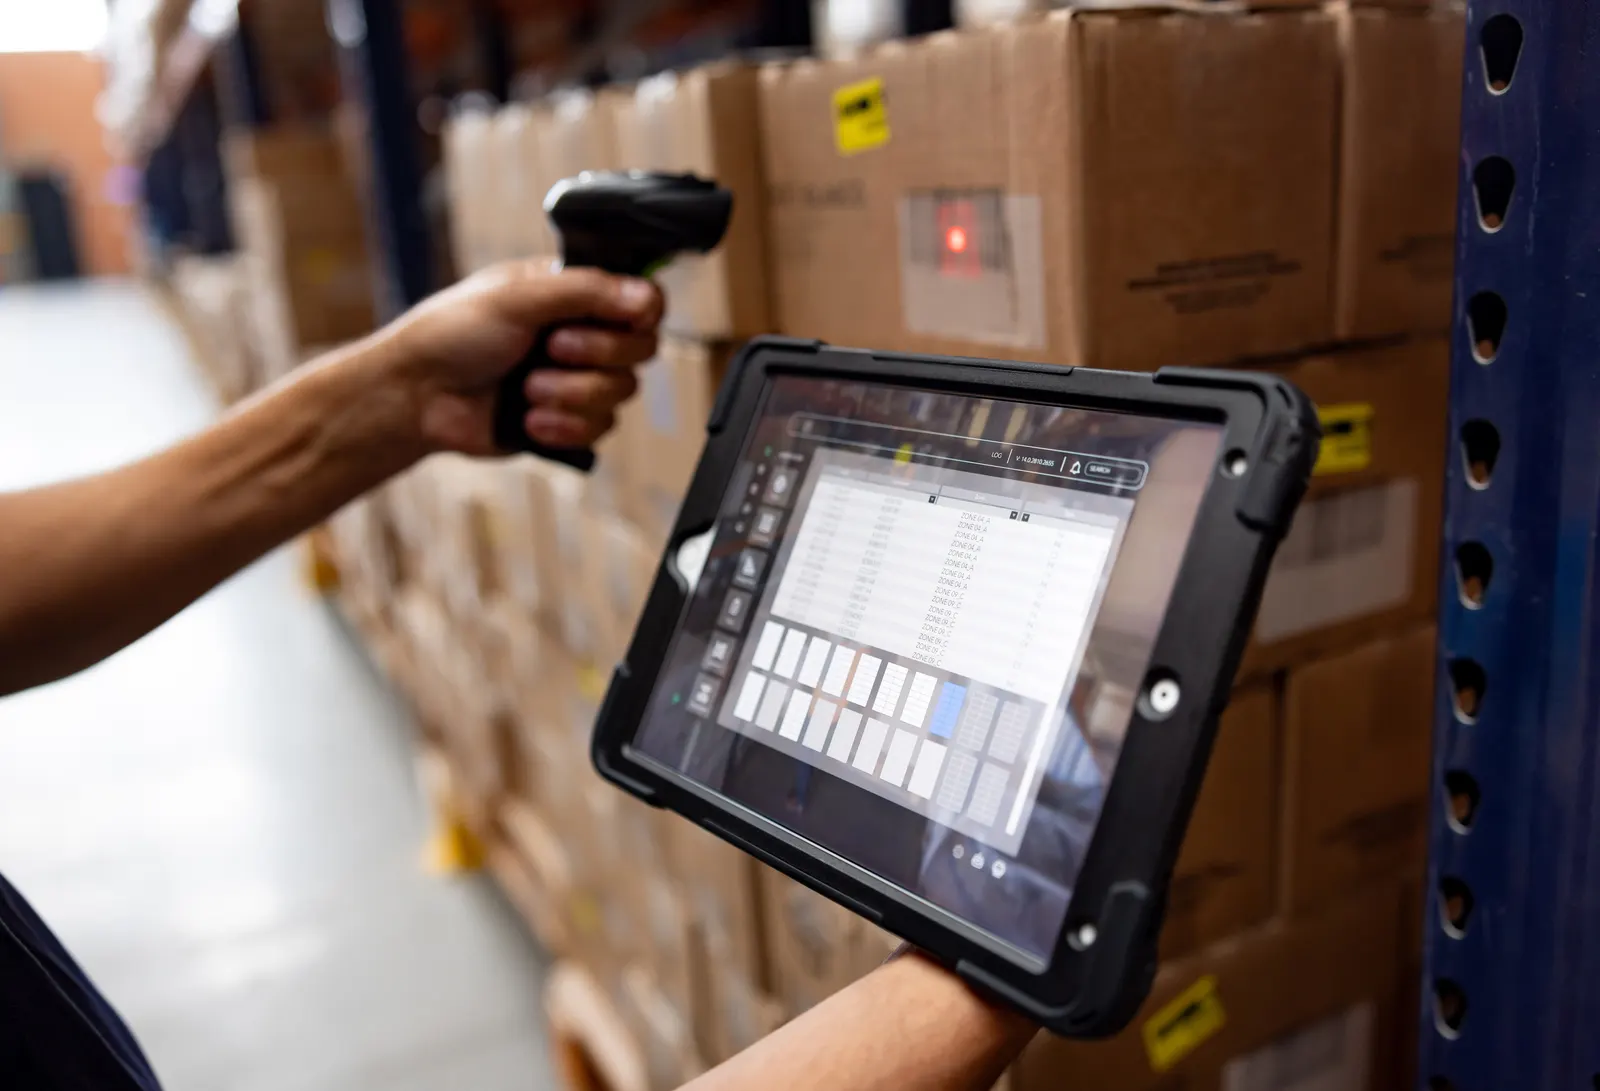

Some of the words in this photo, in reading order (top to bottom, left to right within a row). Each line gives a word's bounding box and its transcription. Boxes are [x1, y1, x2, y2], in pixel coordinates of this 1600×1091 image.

[991, 451, 1002, 459] LOG
[1089, 465, 1111, 474] SEARCH
[961, 512, 977, 521] ZONE
[958, 521, 974, 530] ZONE
[974, 524, 987, 532] 04_A
[955, 531, 970, 539] ZONE
[971, 534, 983, 542] 04_A
[951, 540, 967, 549] ZONE
[968, 543, 981, 552] 04_A
[948, 549, 964, 558] ZONE
[964, 553, 977, 561] 04_A
[945, 558, 960, 567] ZONE
[961, 562, 973, 571] 04_A
[941, 567, 957, 577] ZONE
[958, 571, 970, 580] 04_A
[938, 576, 954, 586] ZONE
[955, 581, 967, 589] 04_A
[935, 586, 951, 596] ZONE
[932, 596, 948, 605] ZONE
[929, 605, 944, 615] ZONE
[925, 614, 941, 624] ZONE
[922, 623, 938, 633] ZONE
[918, 633, 934, 643] ZONE
[916, 642, 931, 652] ZONE
[912, 652, 928, 662] ZONE
